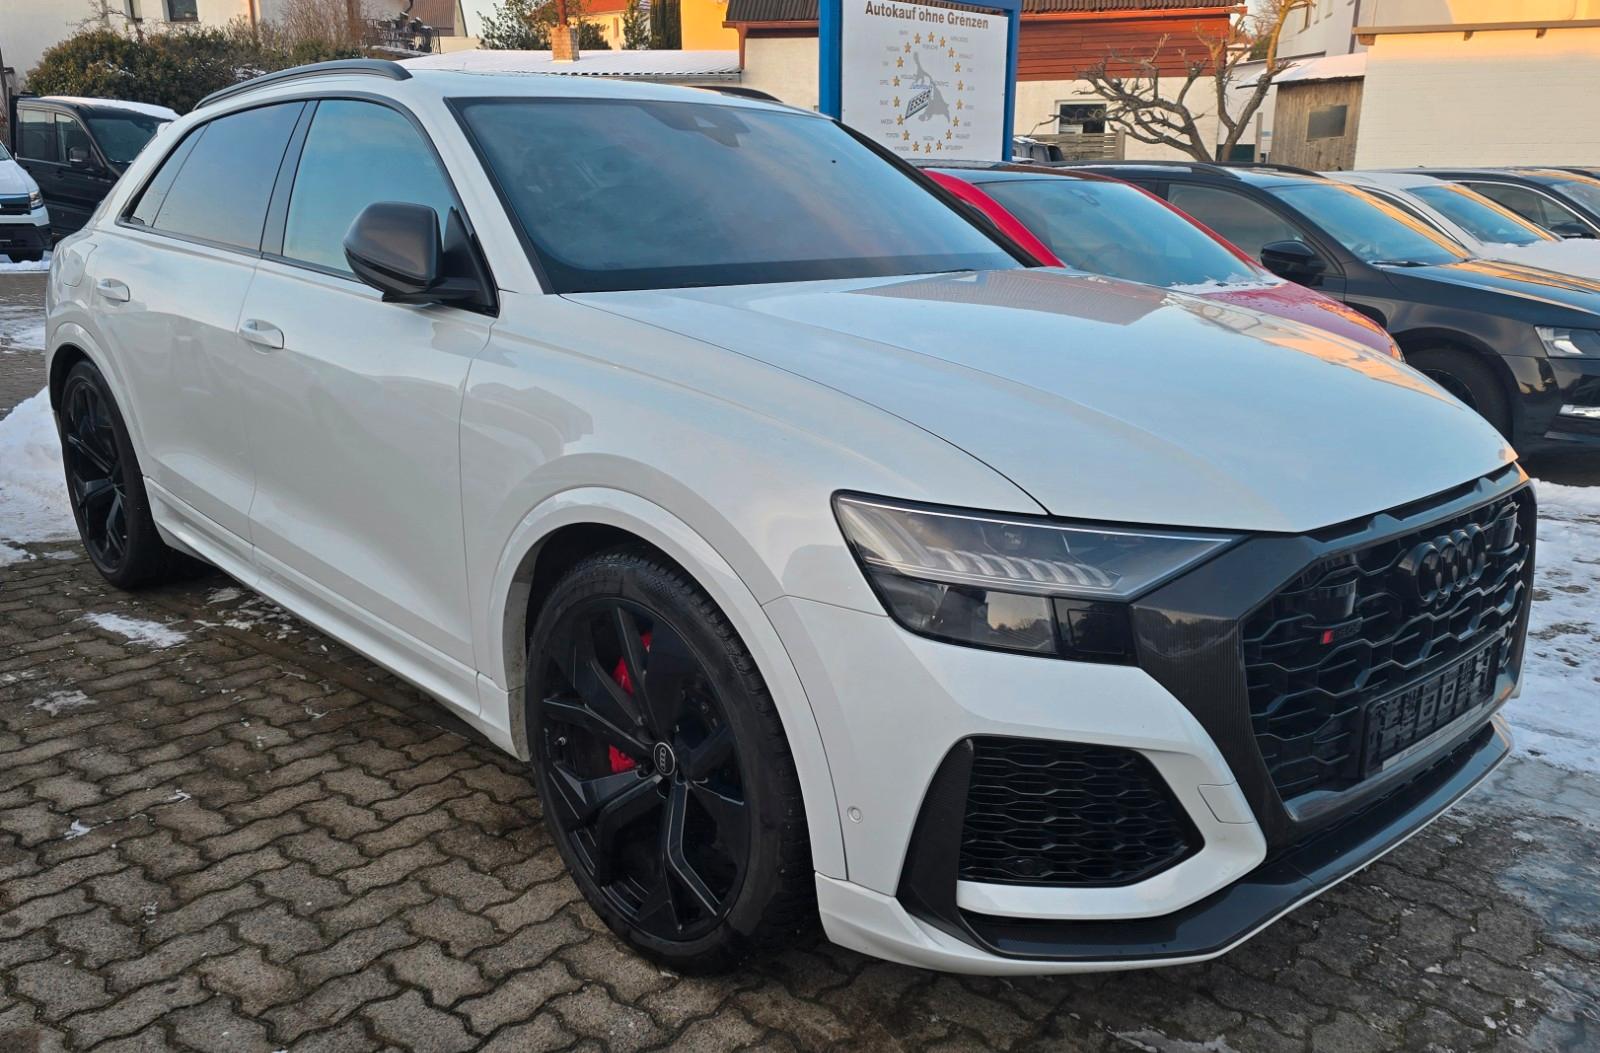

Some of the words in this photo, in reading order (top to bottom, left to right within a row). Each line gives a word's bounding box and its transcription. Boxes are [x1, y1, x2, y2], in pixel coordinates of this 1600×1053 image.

[865, 1, 916, 20] Autokauf
[918, 8, 945, 24] ohne
[947, 12, 989, 29] Grenzen
